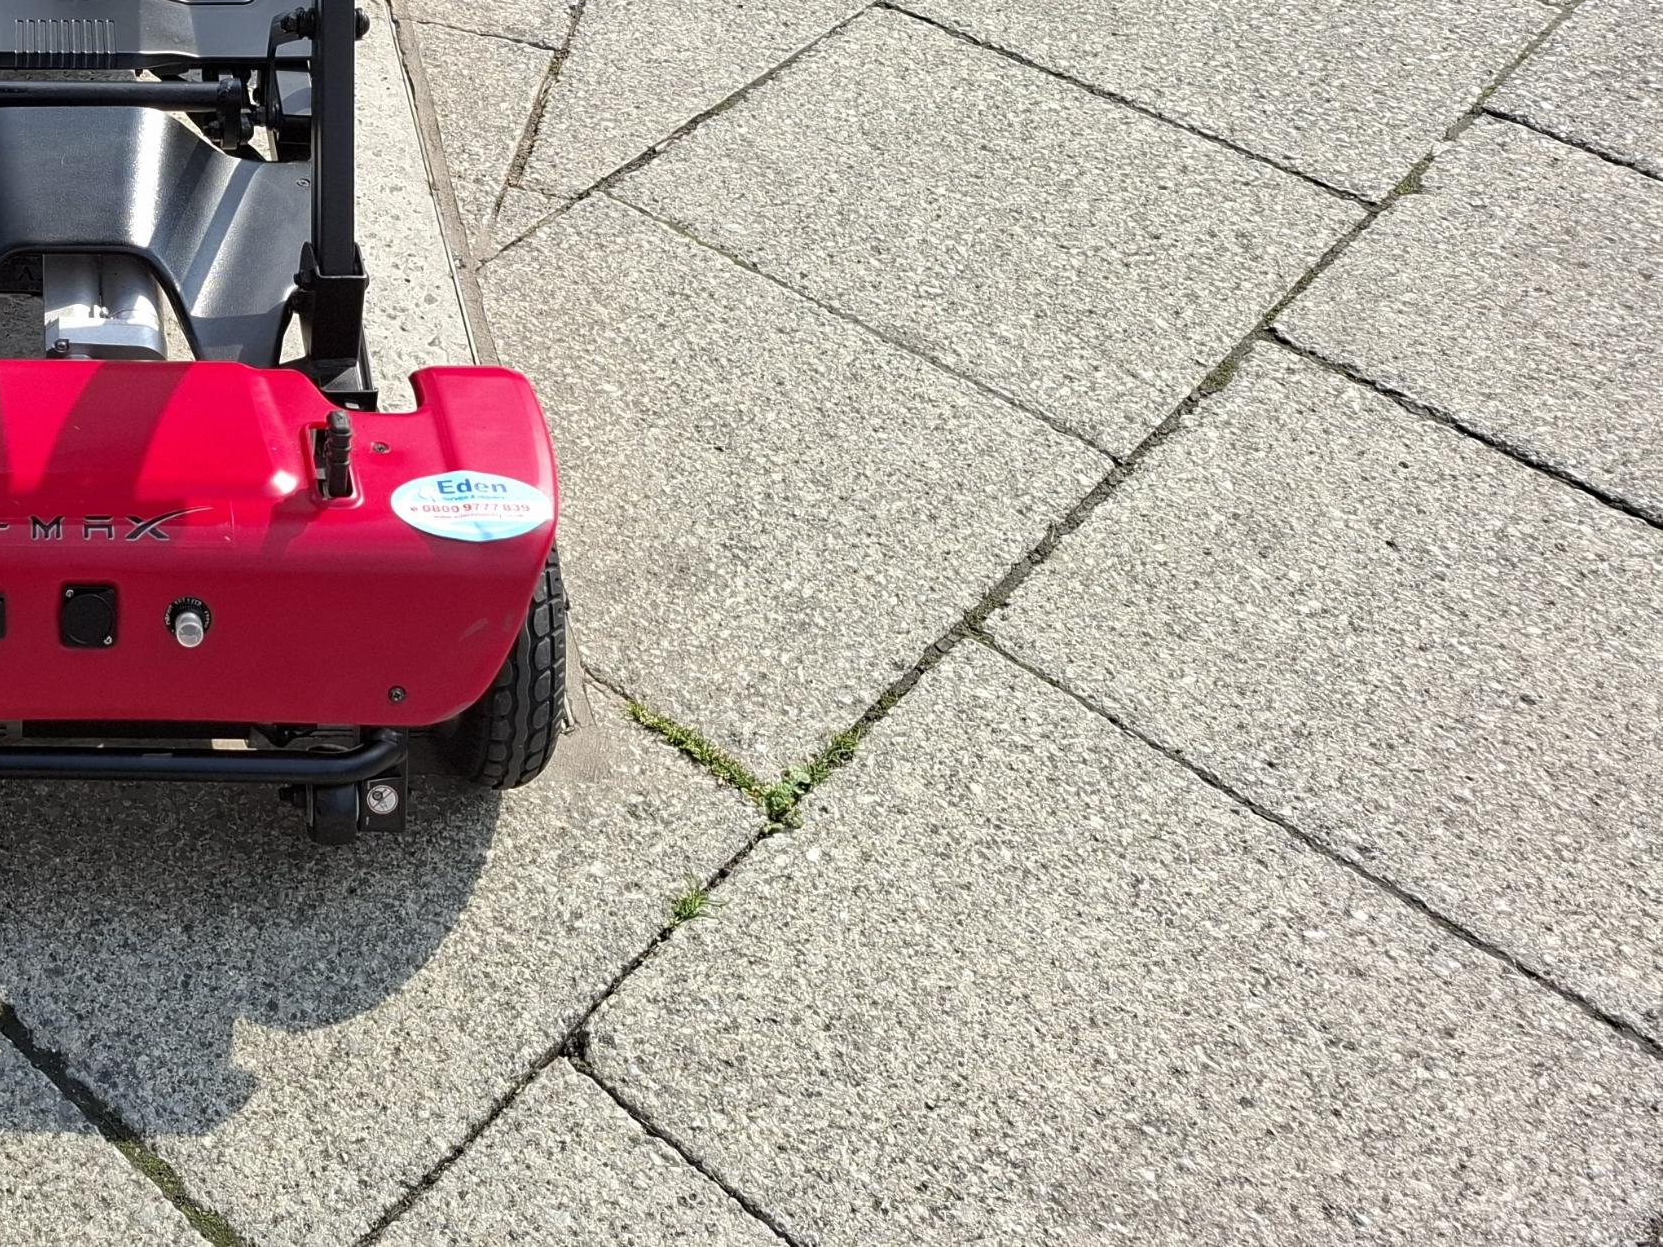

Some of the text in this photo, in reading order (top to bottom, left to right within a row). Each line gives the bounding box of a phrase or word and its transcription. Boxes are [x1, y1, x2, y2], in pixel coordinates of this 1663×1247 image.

[437, 478, 507, 495] Eden
[422, 503, 530, 513] 0800 9777 839
